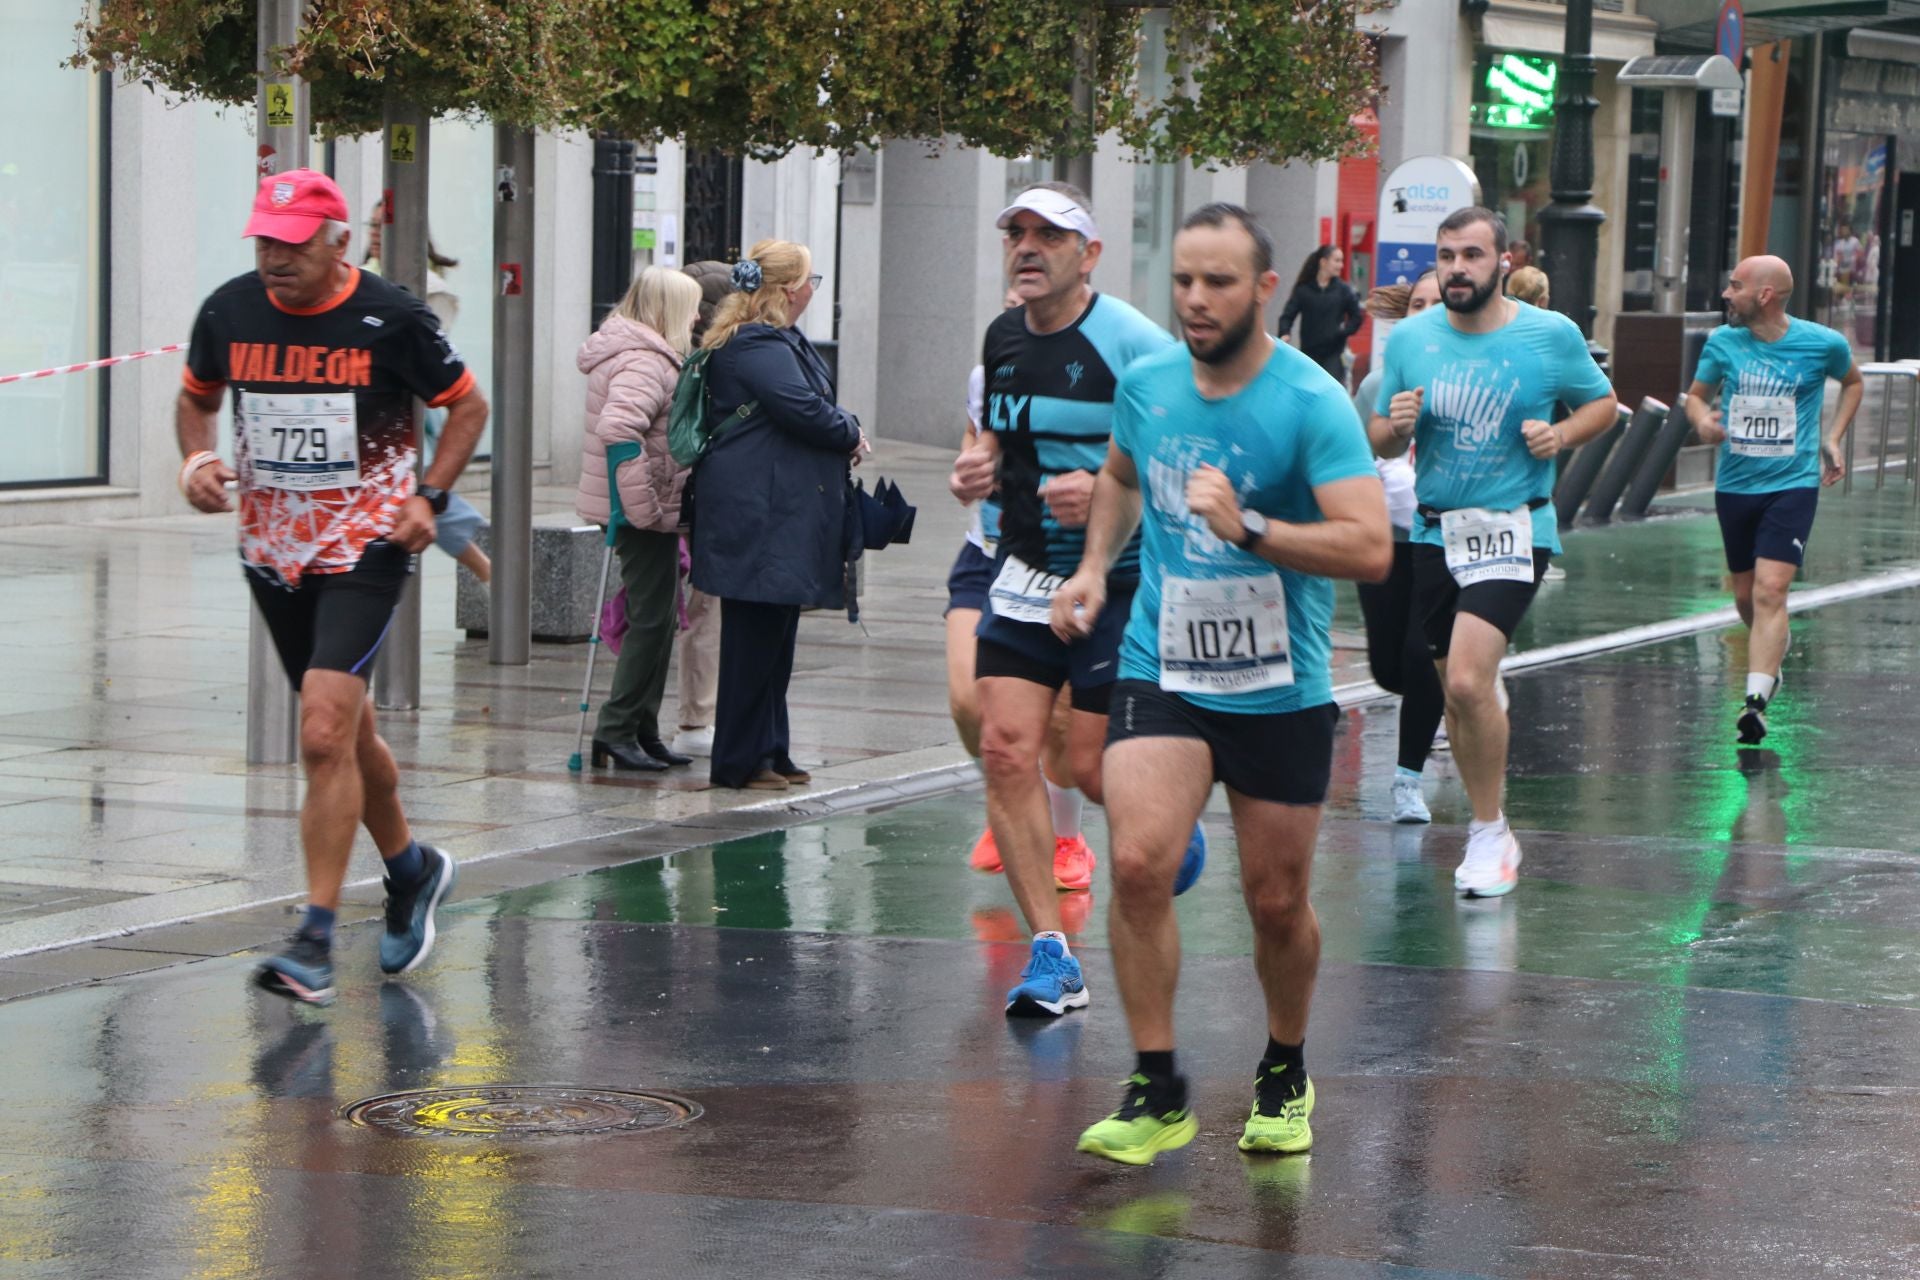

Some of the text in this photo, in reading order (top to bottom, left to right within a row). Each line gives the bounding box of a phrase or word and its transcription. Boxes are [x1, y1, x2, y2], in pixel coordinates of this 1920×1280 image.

[1407, 184, 1449, 199] alsa
[229, 342, 371, 386] VALDEÓN
[1743, 416, 1779, 438] 700
[271, 427, 327, 462] 729
[1466, 530, 1514, 562] 940
[1187, 617, 1258, 659] 1021
